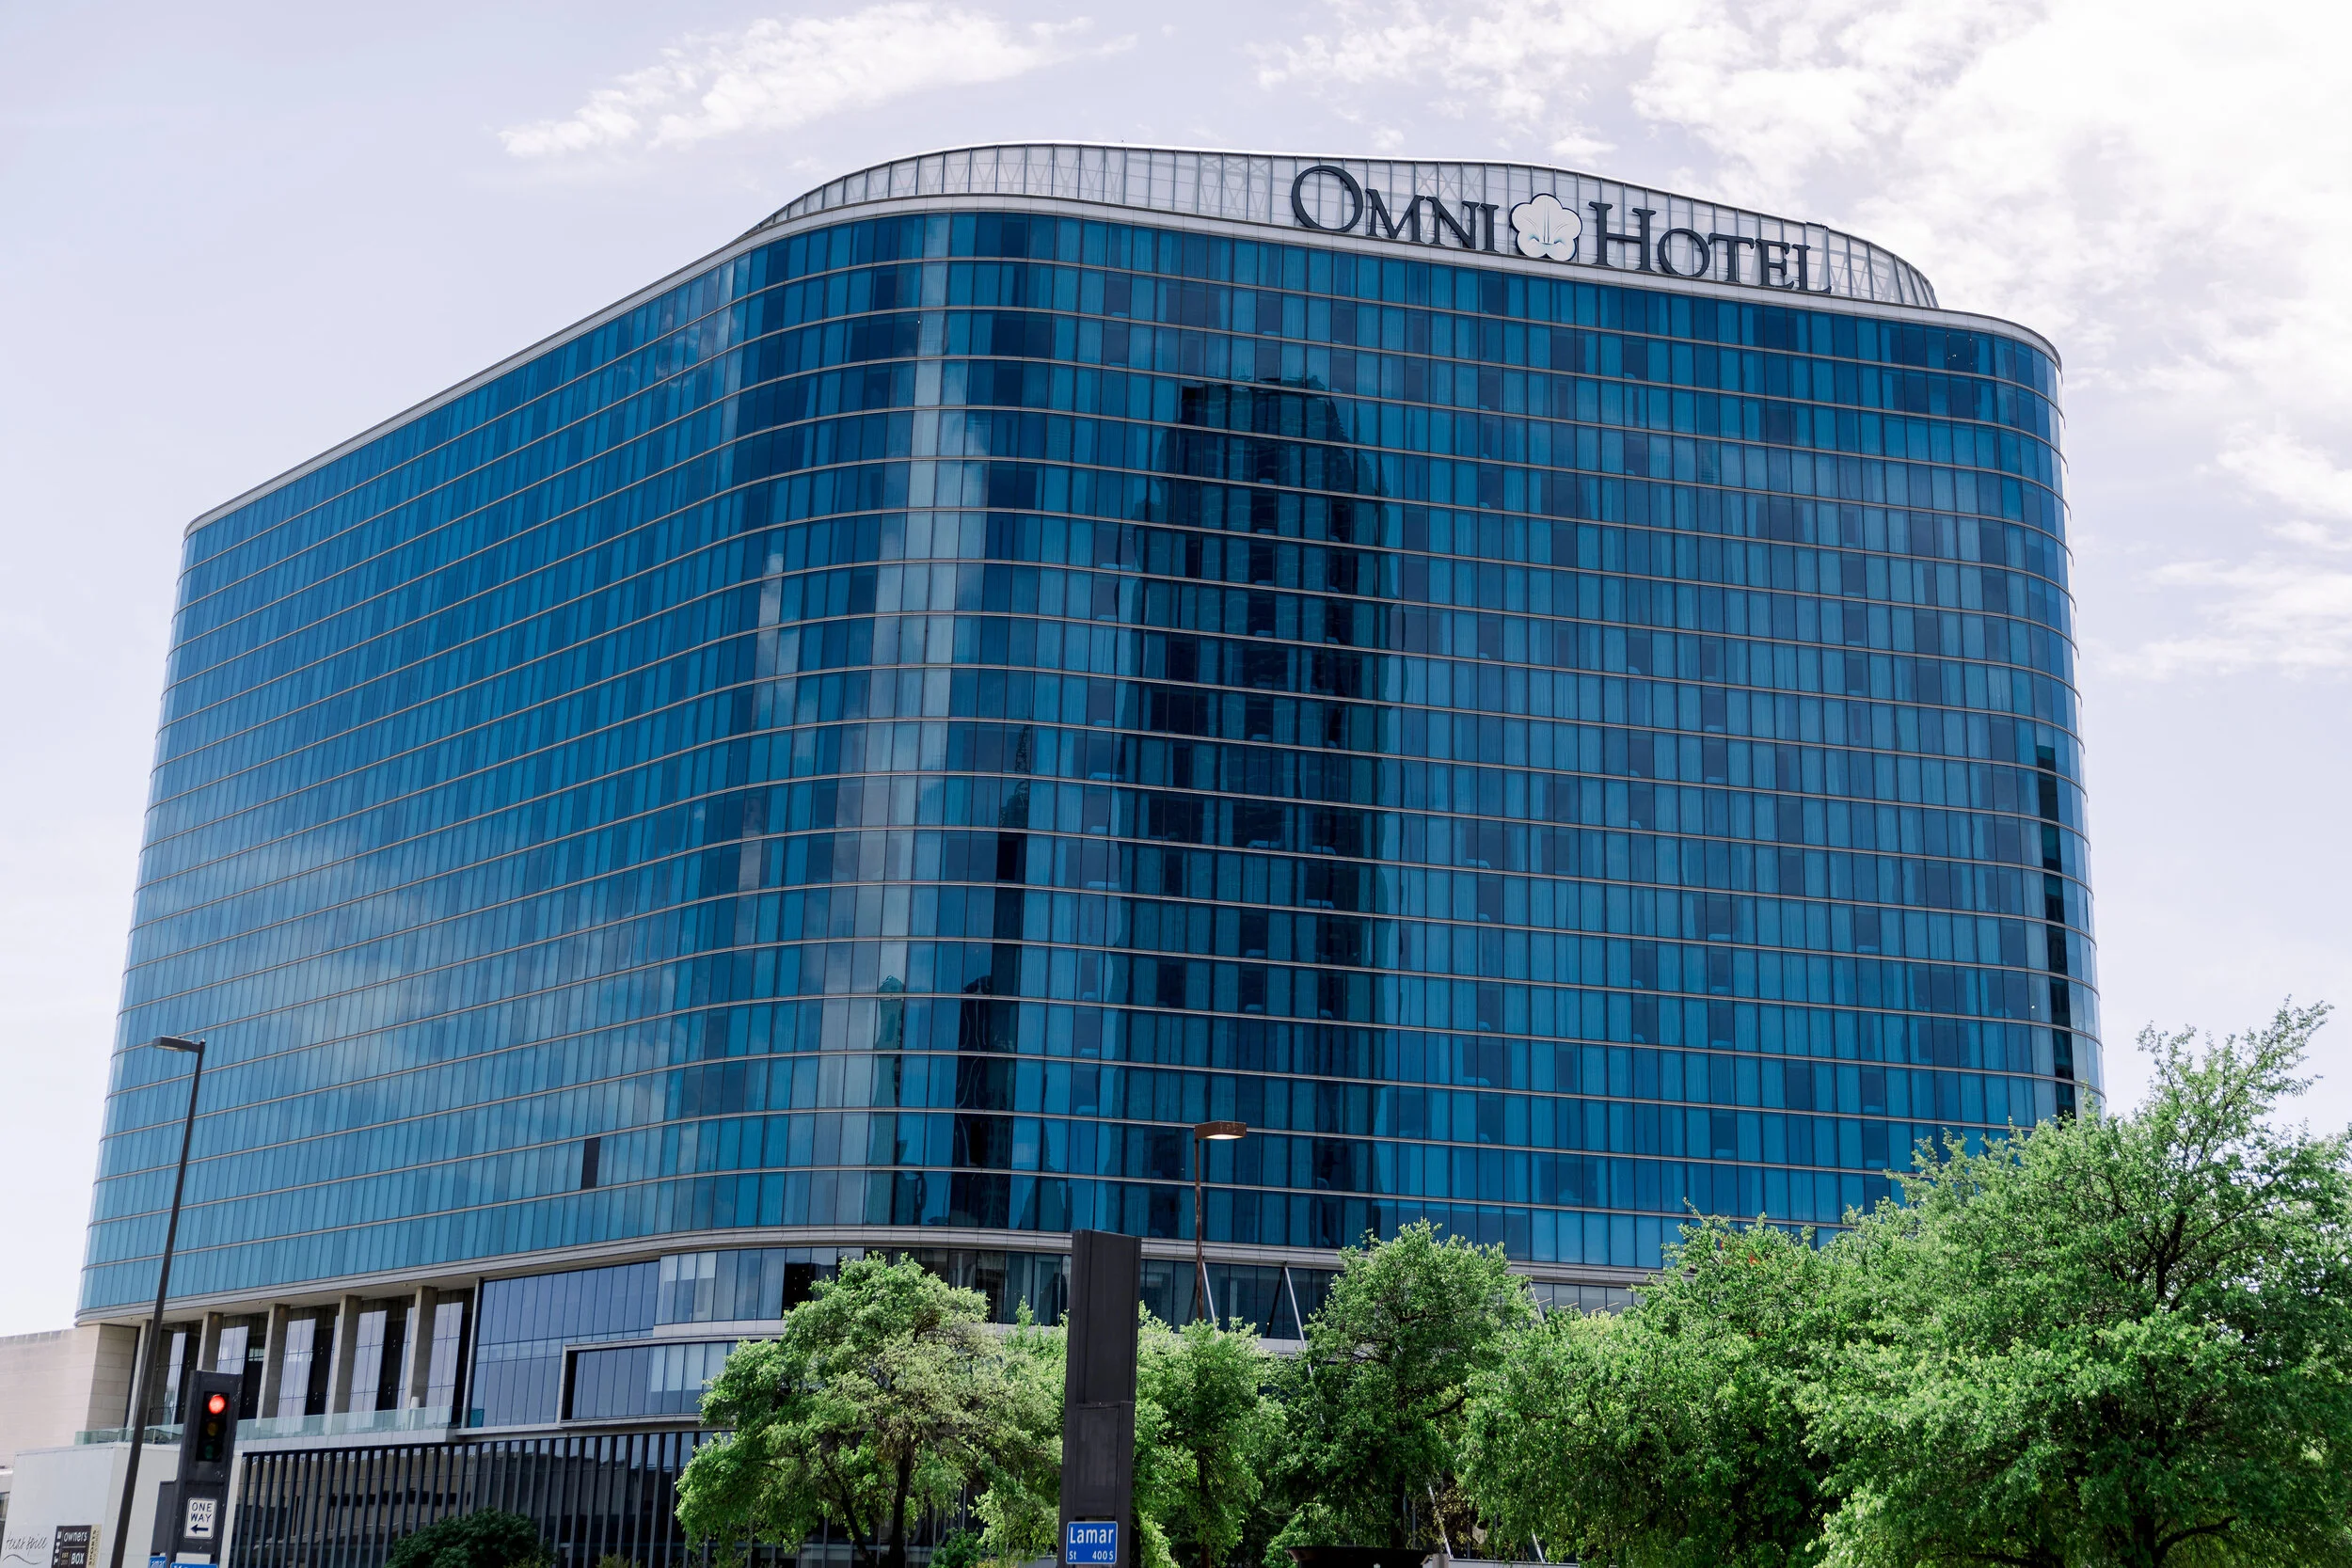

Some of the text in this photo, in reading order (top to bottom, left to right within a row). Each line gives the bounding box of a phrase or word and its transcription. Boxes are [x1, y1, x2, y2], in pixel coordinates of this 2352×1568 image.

[1291, 165, 1832, 293] OMNI HOTEL
[191, 1502, 213, 1512] ONE
[190, 1513, 212, 1522] WAY
[63, 1531, 87, 1543] owners
[1070, 1527, 1114, 1544] Lamar
[71, 1552, 85, 1565] BOX
[1069, 1550, 1114, 1560] St 400 S
